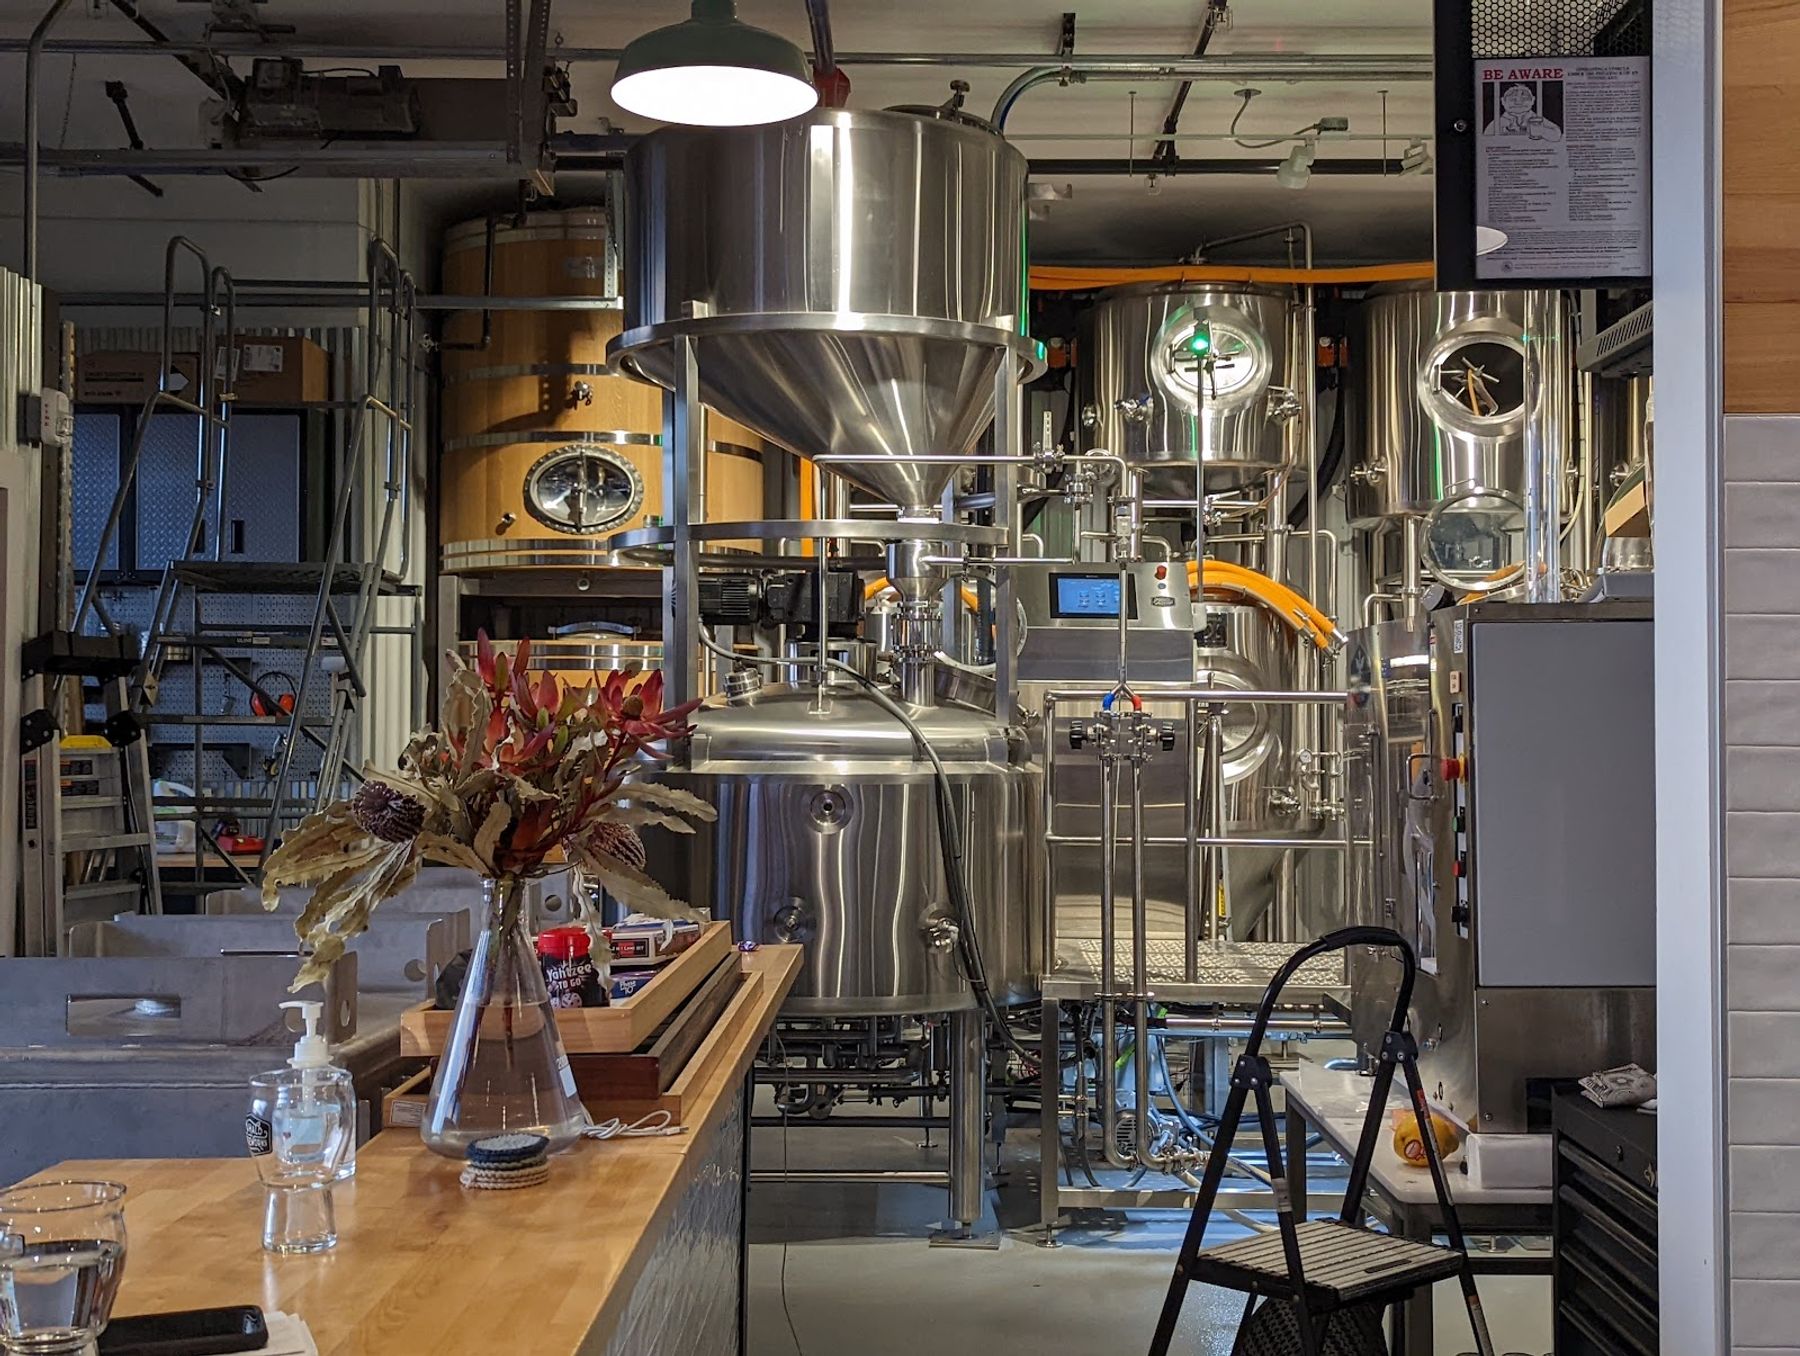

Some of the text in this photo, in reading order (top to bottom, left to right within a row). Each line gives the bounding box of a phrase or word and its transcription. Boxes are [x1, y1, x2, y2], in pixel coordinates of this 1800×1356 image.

[1483, 69, 1504, 80] BE
[1508, 68, 1564, 80] AWARE
[546, 963, 592, 982] Yahtzee
[558, 977, 581, 990] TO GO
[624, 985, 634, 995] 10
